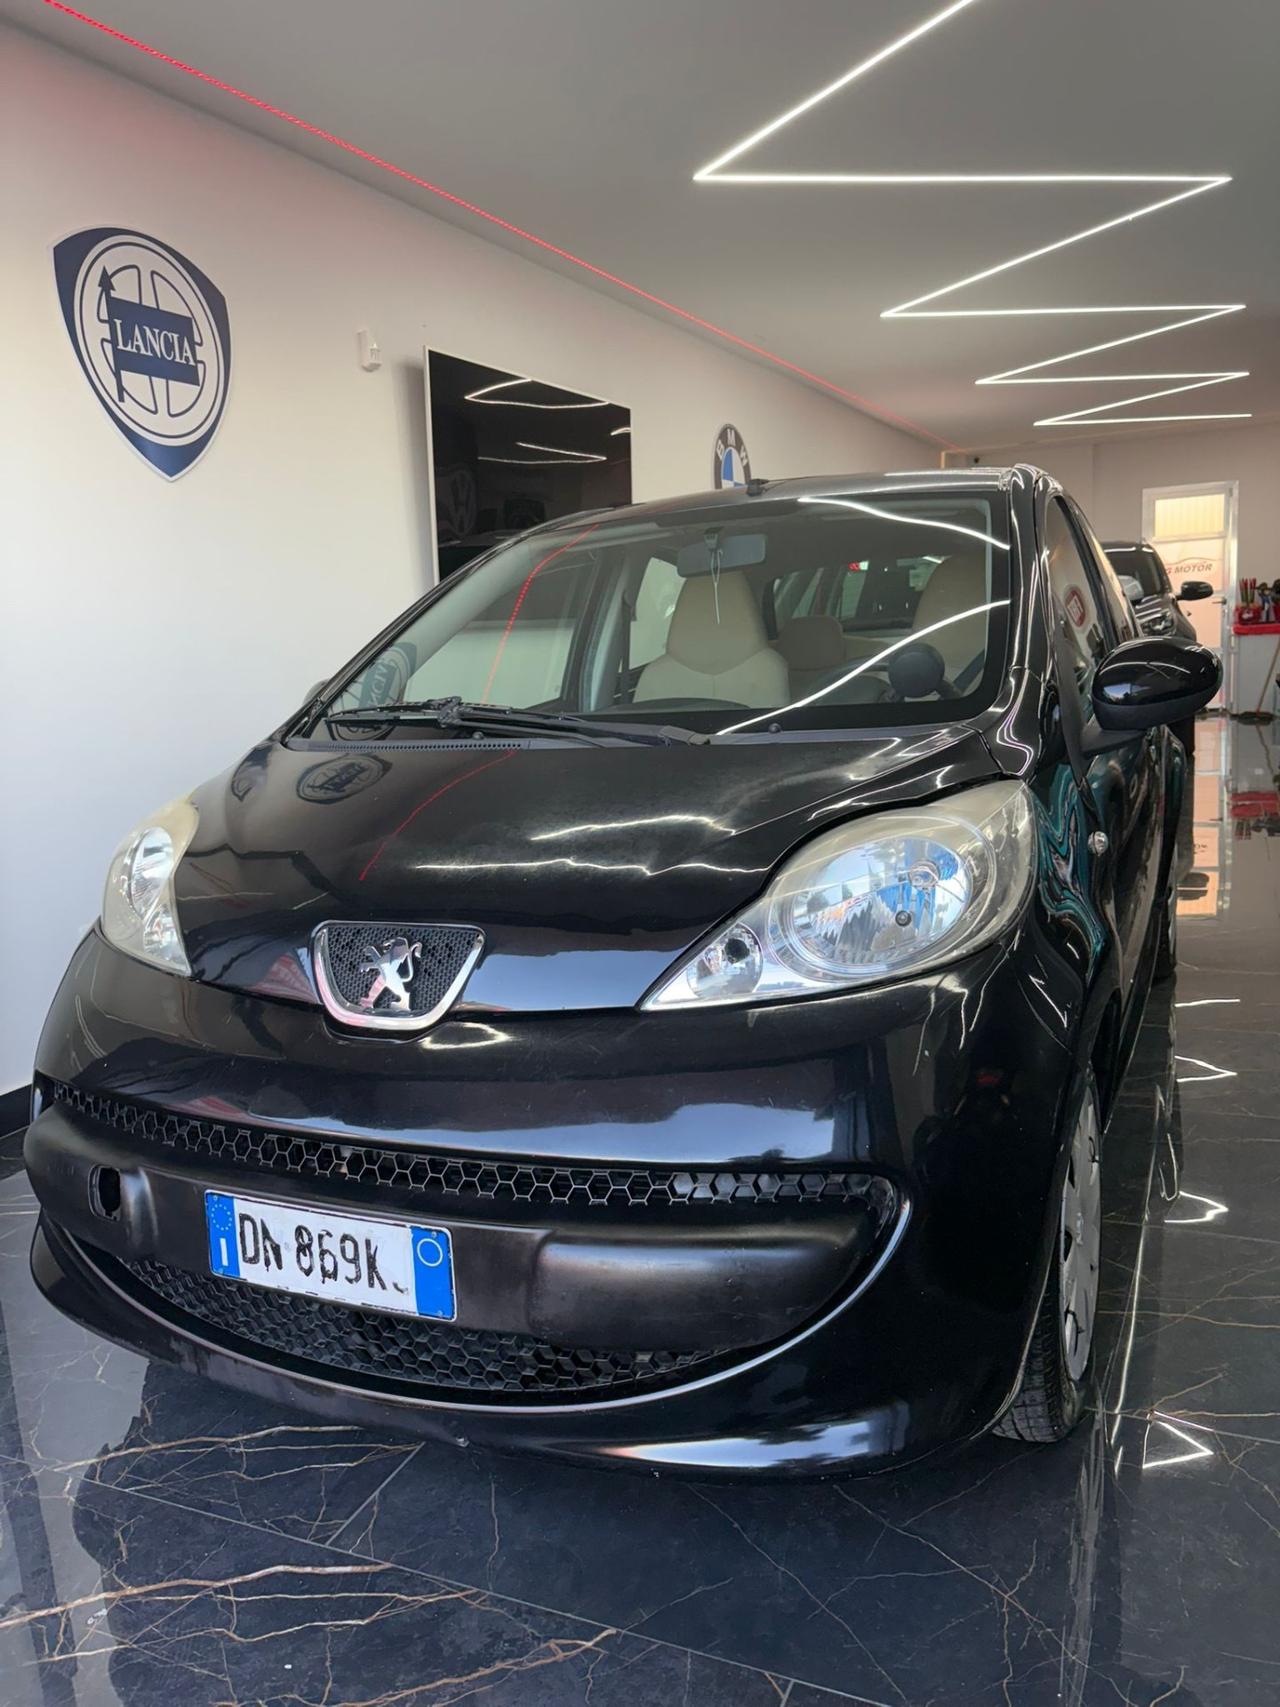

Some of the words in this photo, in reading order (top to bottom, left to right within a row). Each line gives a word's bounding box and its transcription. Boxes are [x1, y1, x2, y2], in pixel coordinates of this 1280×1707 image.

[113, 318, 196, 366] LANCIA
[1174, 563, 1213, 574] MOTOR
[294, 1224, 409, 1294] 869K
